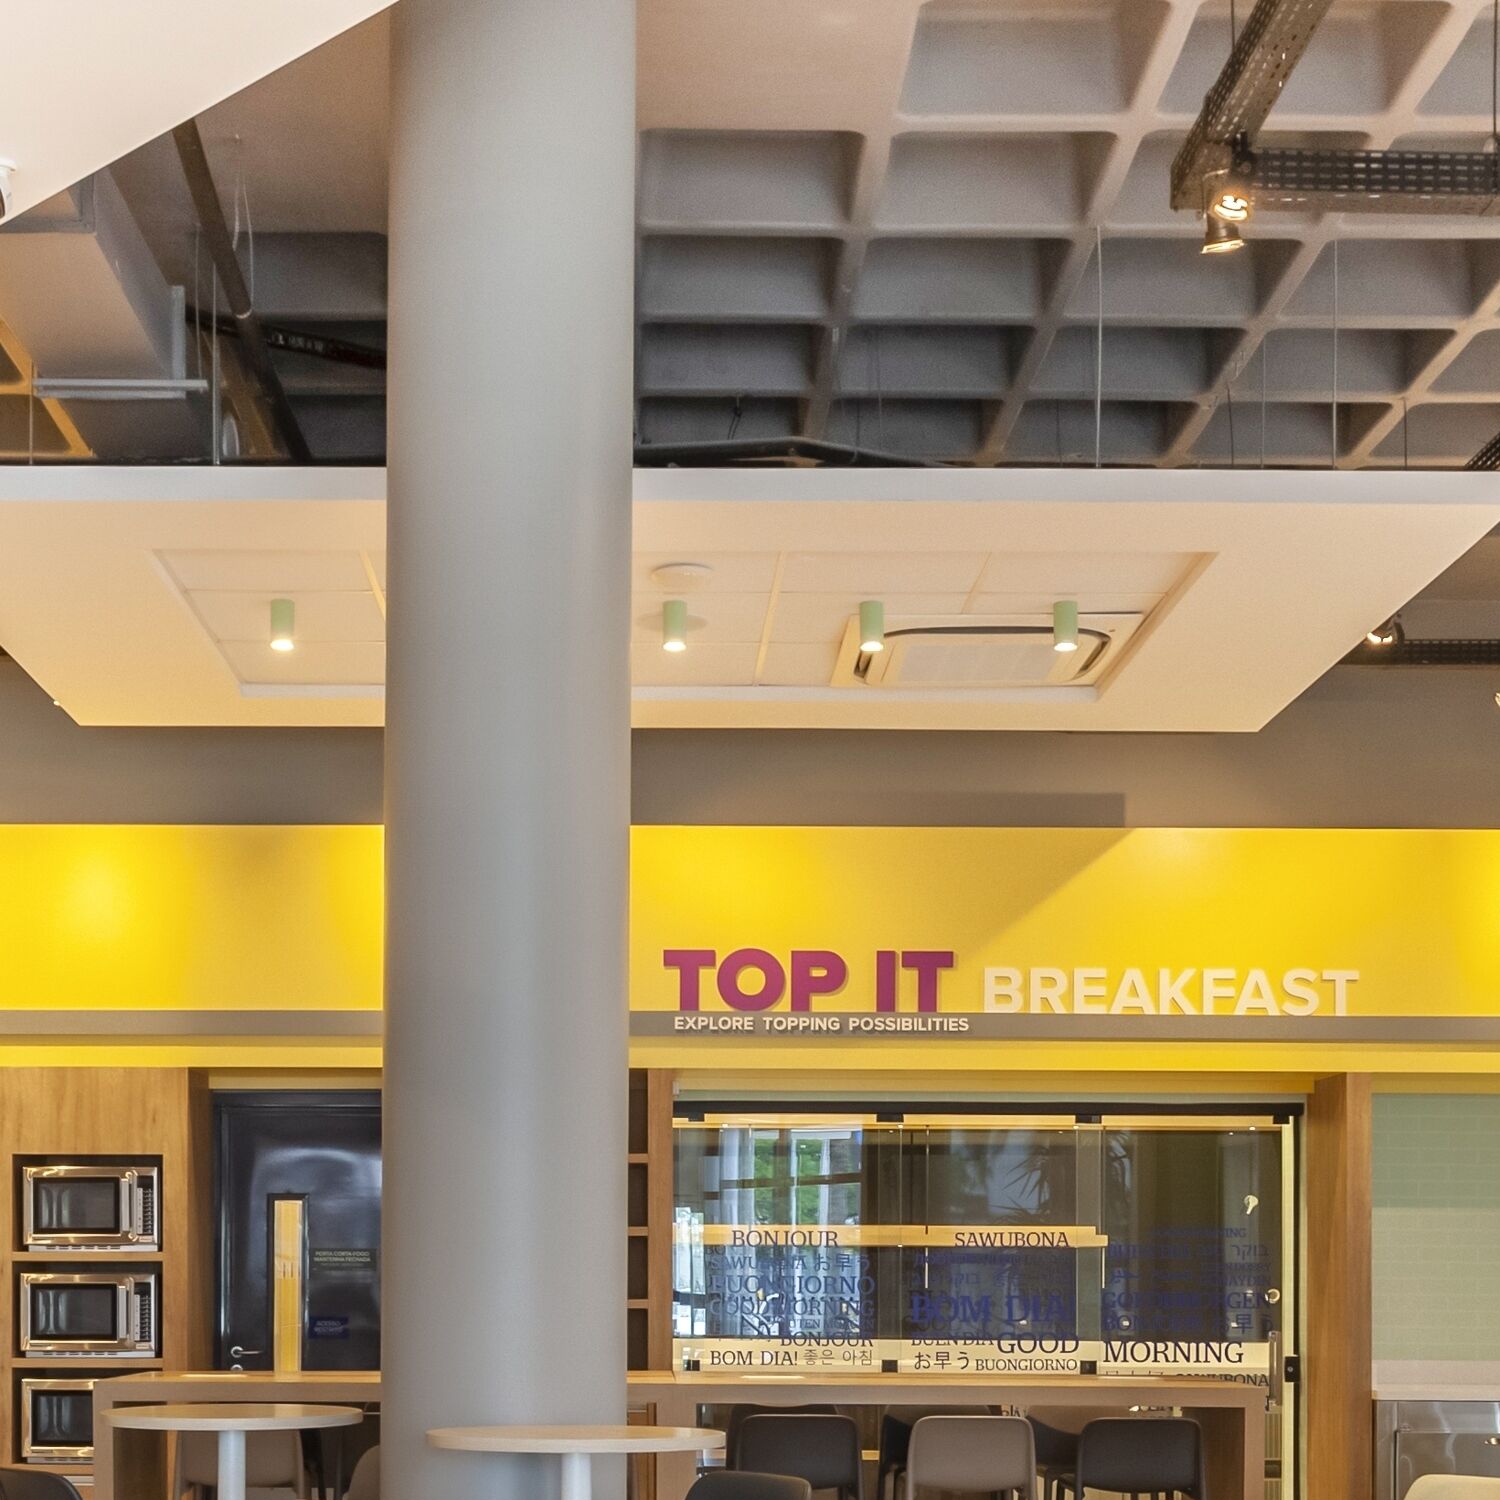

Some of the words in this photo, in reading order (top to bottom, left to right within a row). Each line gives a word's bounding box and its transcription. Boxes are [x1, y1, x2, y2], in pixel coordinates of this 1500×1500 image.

[663, 948, 847, 1012] TOP
[876, 950, 954, 1012] IT
[983, 967, 1360, 1017] BREAKFAST
[674, 1016, 754, 1031] EXPLORE
[762, 1016, 841, 1032] TOPPING
[848, 1017, 970, 1032] POSSIBILITIES
[732, 1230, 839, 1248] BONJOUR
[954, 1232, 1070, 1248] SAWUBONA
[710, 1254, 808, 1270] SAWUNA
[780, 1331, 874, 1348] BONJOUR
[997, 1331, 1080, 1354] GOOD
[1103, 1341, 1244, 1363] MORNING
[710, 1350, 753, 1366] BOM
[760, 1350, 798, 1366] DIA!
[803, 1349, 835, 1366] 좋은
[842, 1349, 873, 1366] 아침
[975, 1358, 1078, 1371] BUONGIORNO
